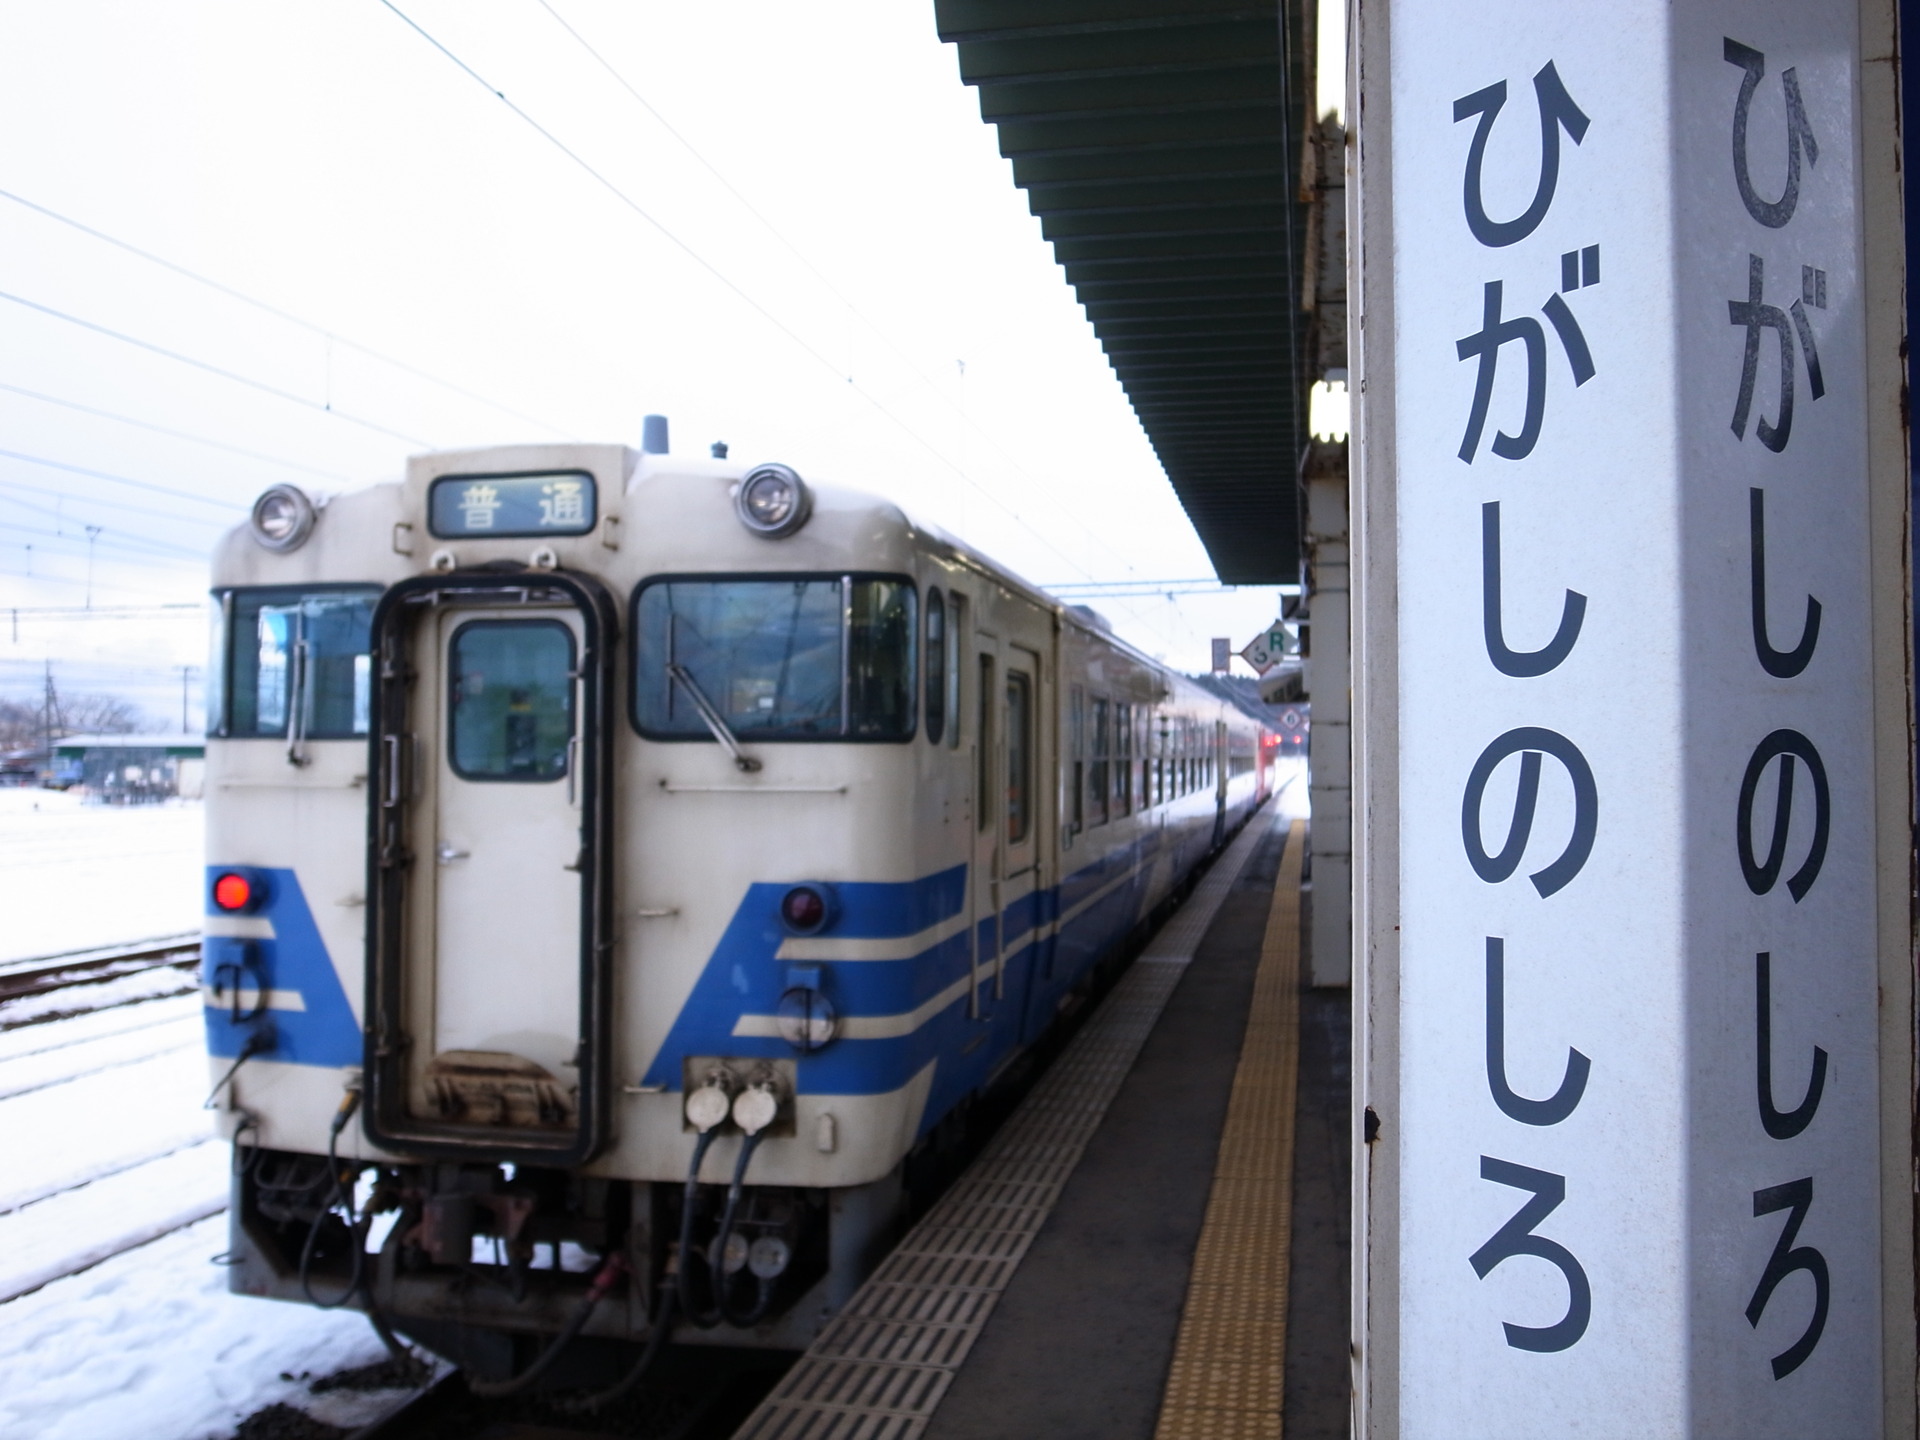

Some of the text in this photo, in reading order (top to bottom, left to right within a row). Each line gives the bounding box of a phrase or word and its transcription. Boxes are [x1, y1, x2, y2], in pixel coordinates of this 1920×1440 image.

[458, 482, 584, 529] 普通
[1270, 631, 1284, 652] R
[1453, 58, 1600, 1354] ひがしのしろ
[1722, 35, 1832, 1381] ひがしのしろ
